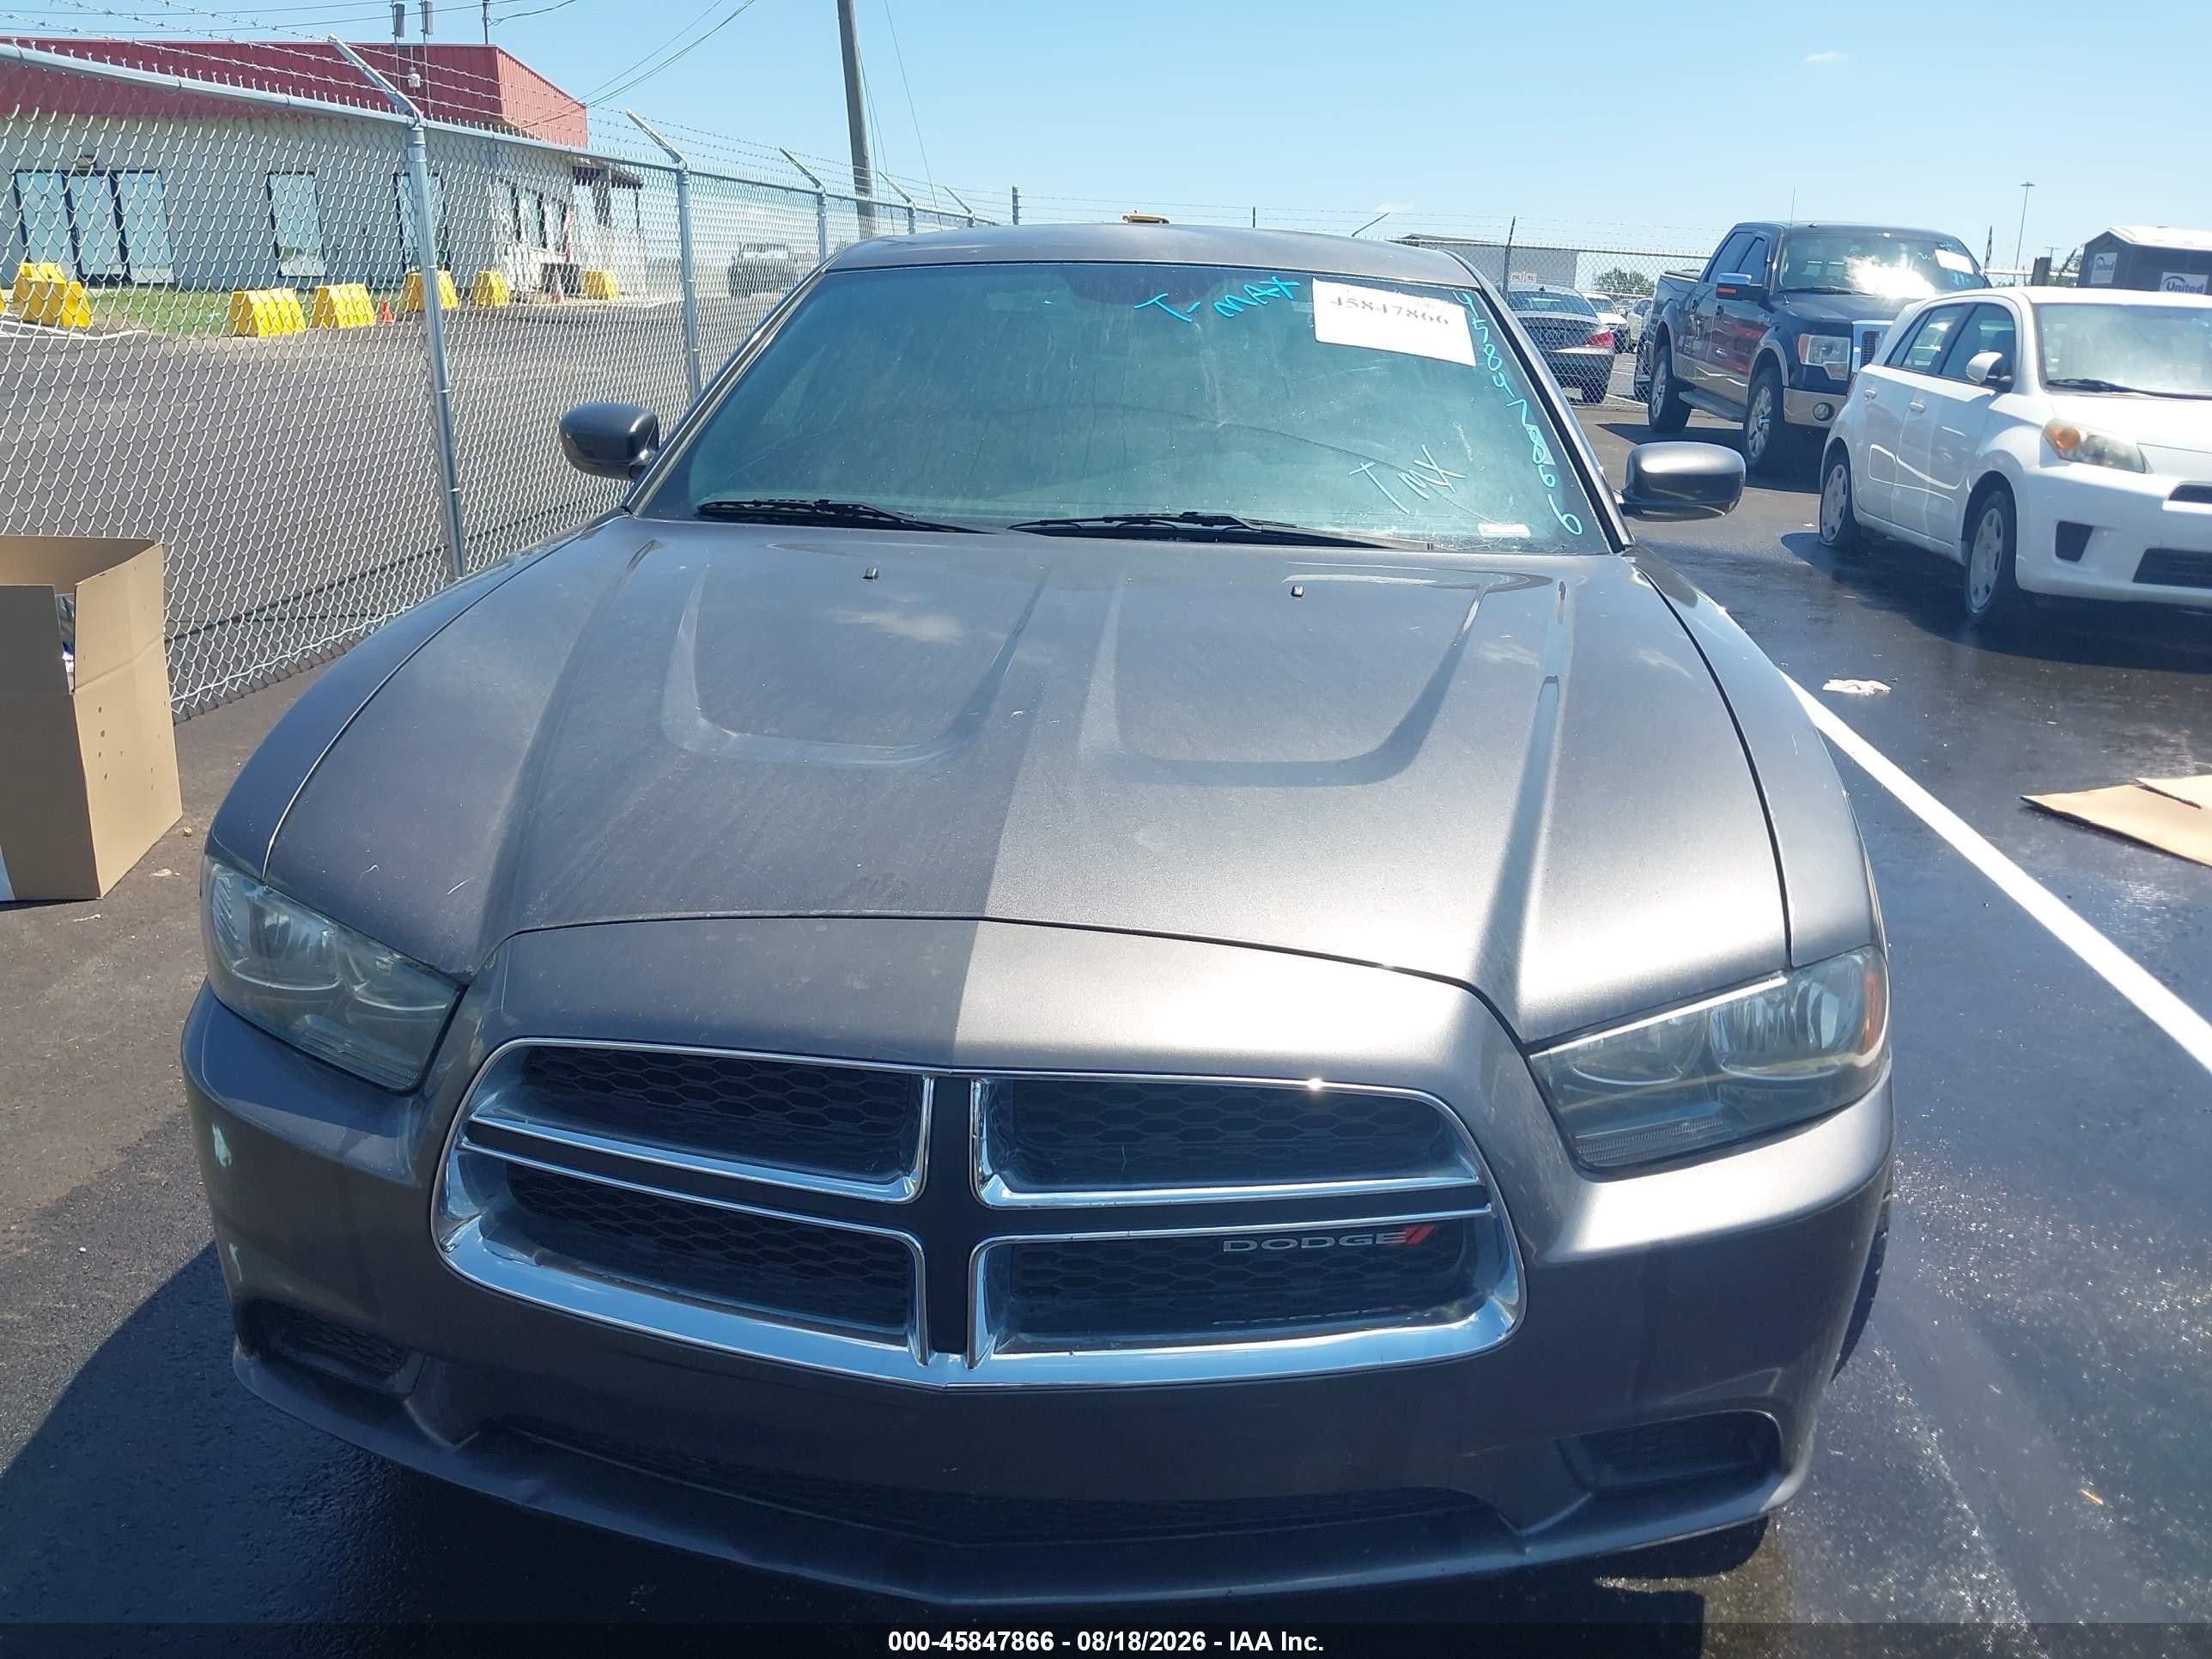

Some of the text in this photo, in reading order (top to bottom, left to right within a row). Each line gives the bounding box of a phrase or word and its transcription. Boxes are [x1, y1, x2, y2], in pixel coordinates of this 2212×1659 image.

[2166, 281, 2204, 294] United
[1330, 295, 1449, 325] 45847866
[1222, 1231, 1407, 1252] DODGE
